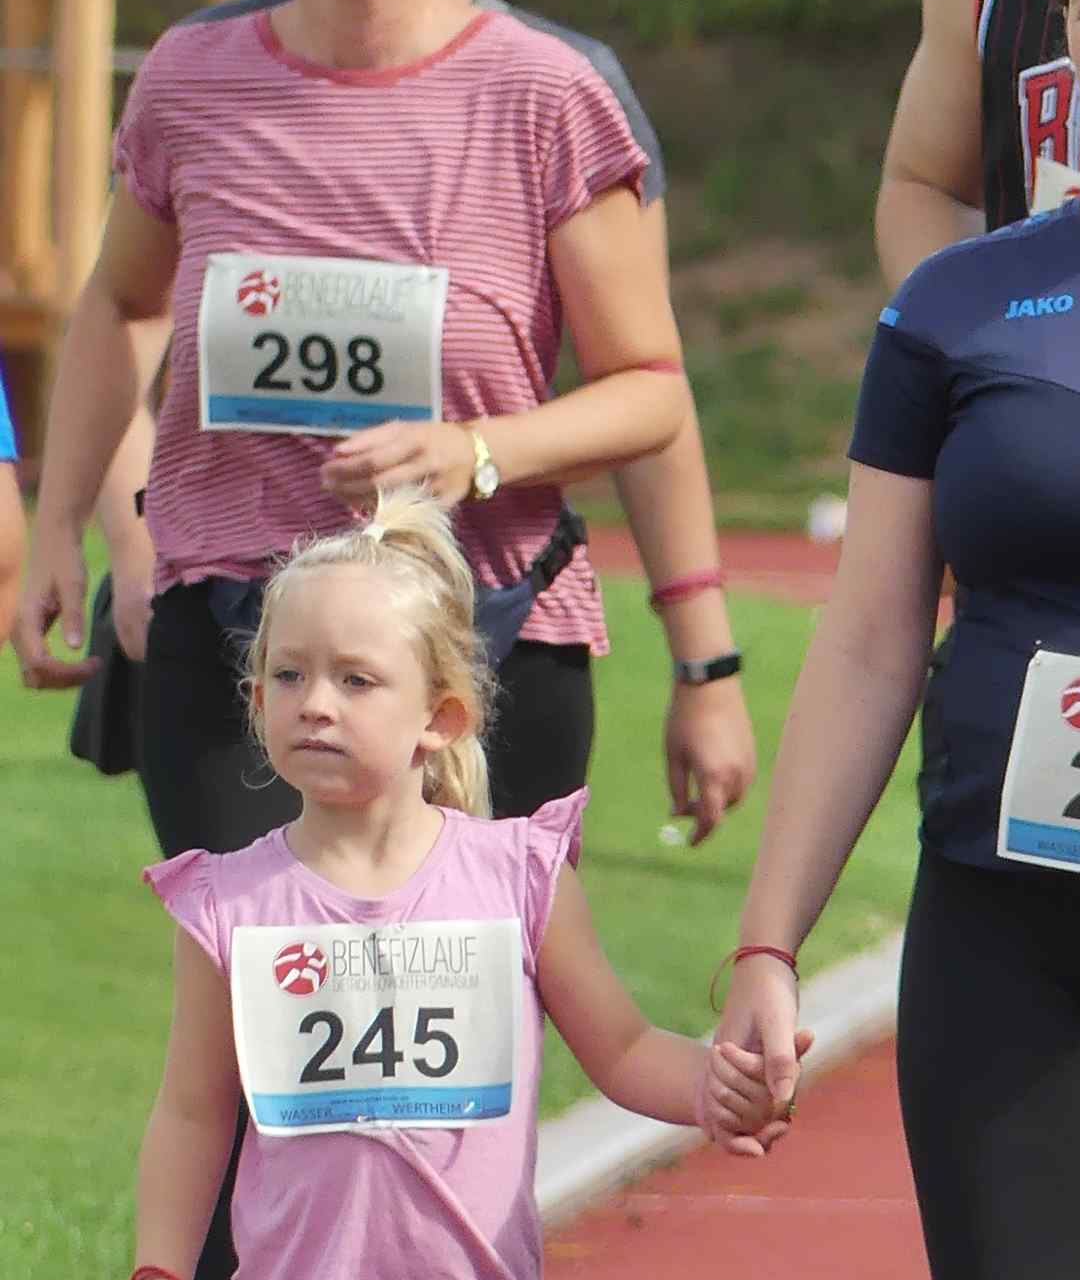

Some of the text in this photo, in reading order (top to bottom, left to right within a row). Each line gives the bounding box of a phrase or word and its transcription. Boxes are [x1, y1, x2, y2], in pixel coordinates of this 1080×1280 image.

[1005, 294, 1073, 320] JAKO
[251, 330, 385, 396] 298
[331, 936, 478, 977] BENEFIZLAUF
[298, 1006, 459, 1084] 245
[392, 1101, 463, 1115] WERTHEIM
